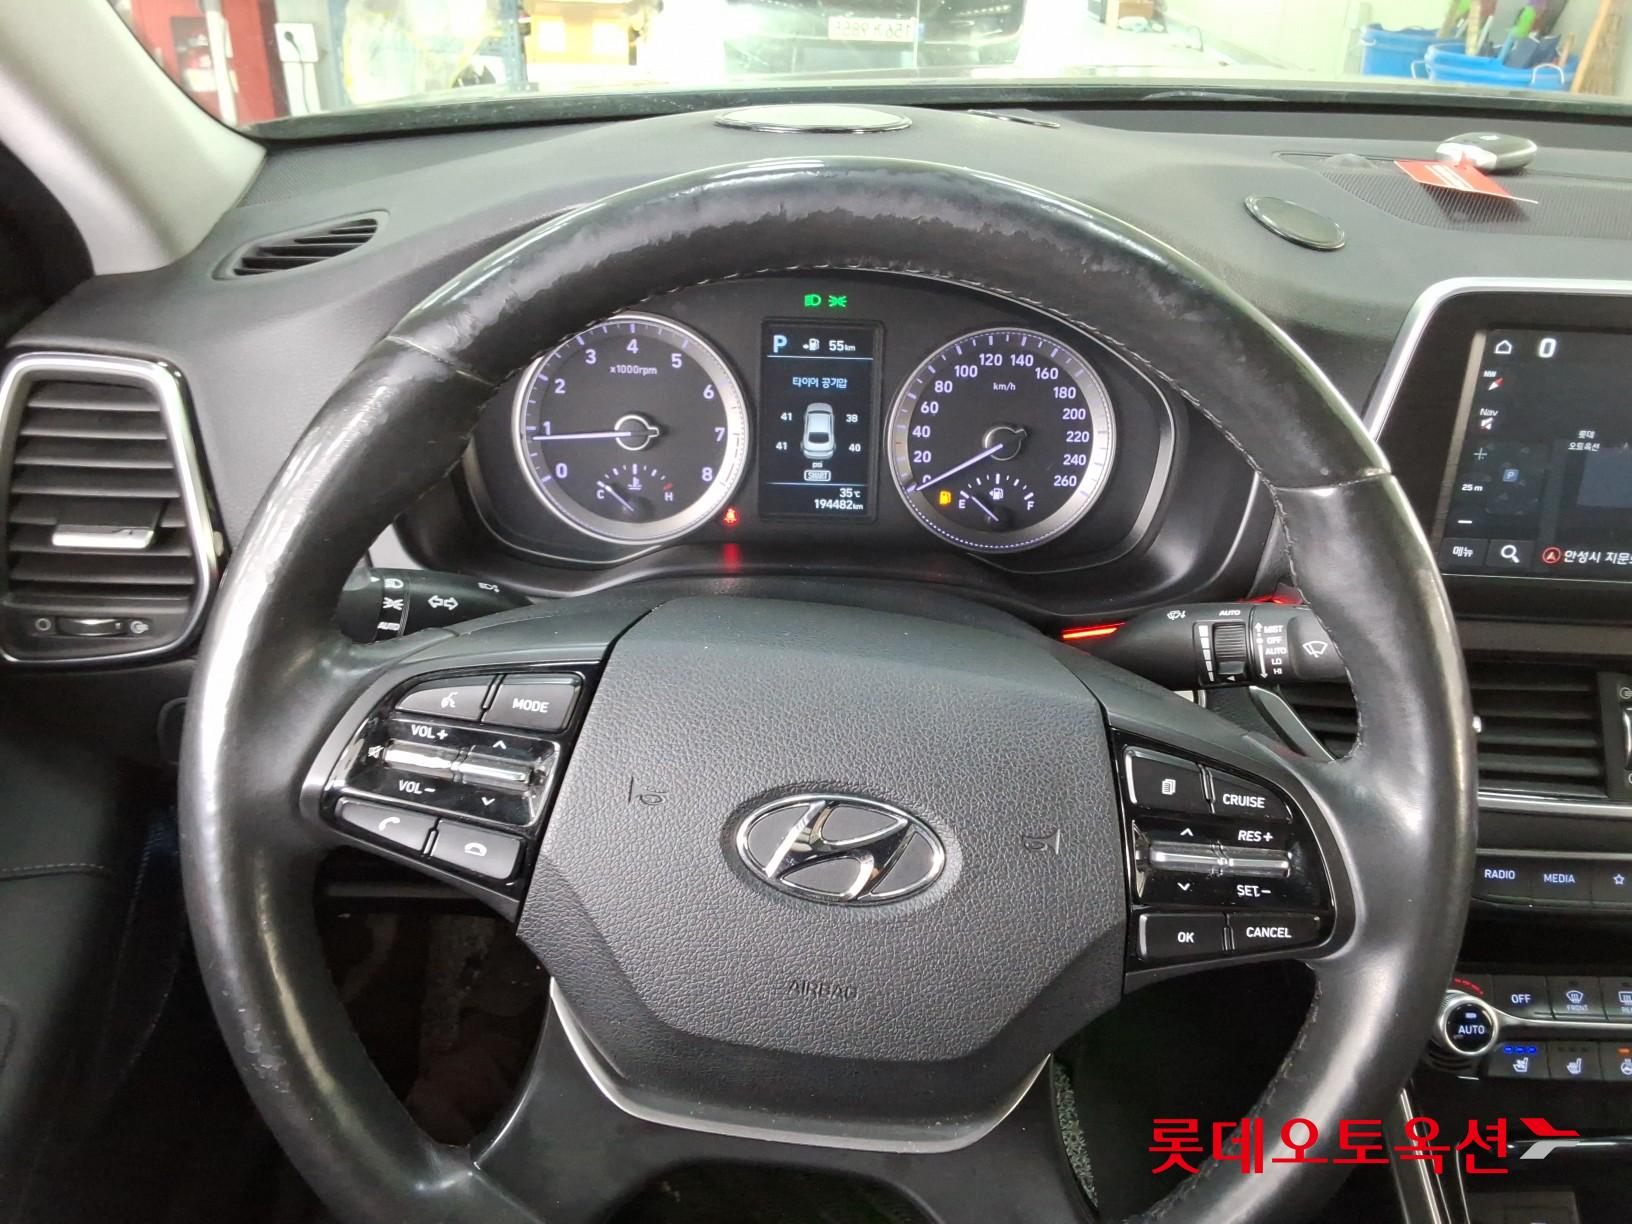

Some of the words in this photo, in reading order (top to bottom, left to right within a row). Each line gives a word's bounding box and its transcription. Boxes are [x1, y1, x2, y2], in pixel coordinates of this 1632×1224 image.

[626, 338, 639, 354] 4
[773, 334, 788, 353] P
[1538, 337, 1557, 358] 0
[585, 349, 597, 364] 3
[671, 353, 683, 369] 5
[979, 353, 1003, 367] 120
[1010, 354, 1034, 368] 140
[954, 365, 978, 378] 100
[1035, 367, 1059, 381] 160
[554, 378, 566, 394] 2
[792, 376, 819, 388] 타이어
[822, 376, 848, 389] 공기압
[934, 380, 953, 393] 80
[992, 382, 1017, 392] km/h
[703, 384, 715, 400] 6
[1053, 386, 1077, 400] 180
[920, 401, 939, 415] 60
[1062, 407, 1086, 421] 200
[1479, 408, 1498, 417] Nav
[780, 412, 793, 422] 41
[846, 413, 858, 424] 38
[543, 421, 551, 435] 1
[714, 426, 726, 443] 7
[912, 425, 931, 439] 40
[1066, 430, 1090, 444] 220
[776, 441, 788, 451] 41
[914, 450, 932, 464] 20
[1063, 454, 1087, 467] 240
[555, 463, 568, 479] 0
[701, 467, 713, 483] 8
[1053, 475, 1078, 488] 260
[596, 489, 605, 499] C
[664, 492, 674, 502] H
[958, 499, 966, 509] E
[1027, 501, 1035, 511] F
[1452, 545, 1473, 557] 메뉴
[1564, 550, 1601, 564] 안성시
[1605, 552, 1632, 565] 지문
[1267, 636, 1282, 645] OFF
[1265, 646, 1287, 655] AUTO
[512, 697, 549, 714] MODE
[1222, 793, 1265, 809] CRUISE
[1484, 868, 1516, 881] RADIO
[1543, 872, 1576, 884] MEDIA
[1177, 931, 1194, 944] OK
[1246, 926, 1292, 940] CANCEL
[1511, 993, 1531, 1005] OFF
[1458, 1025, 1485, 1035] AUTO
